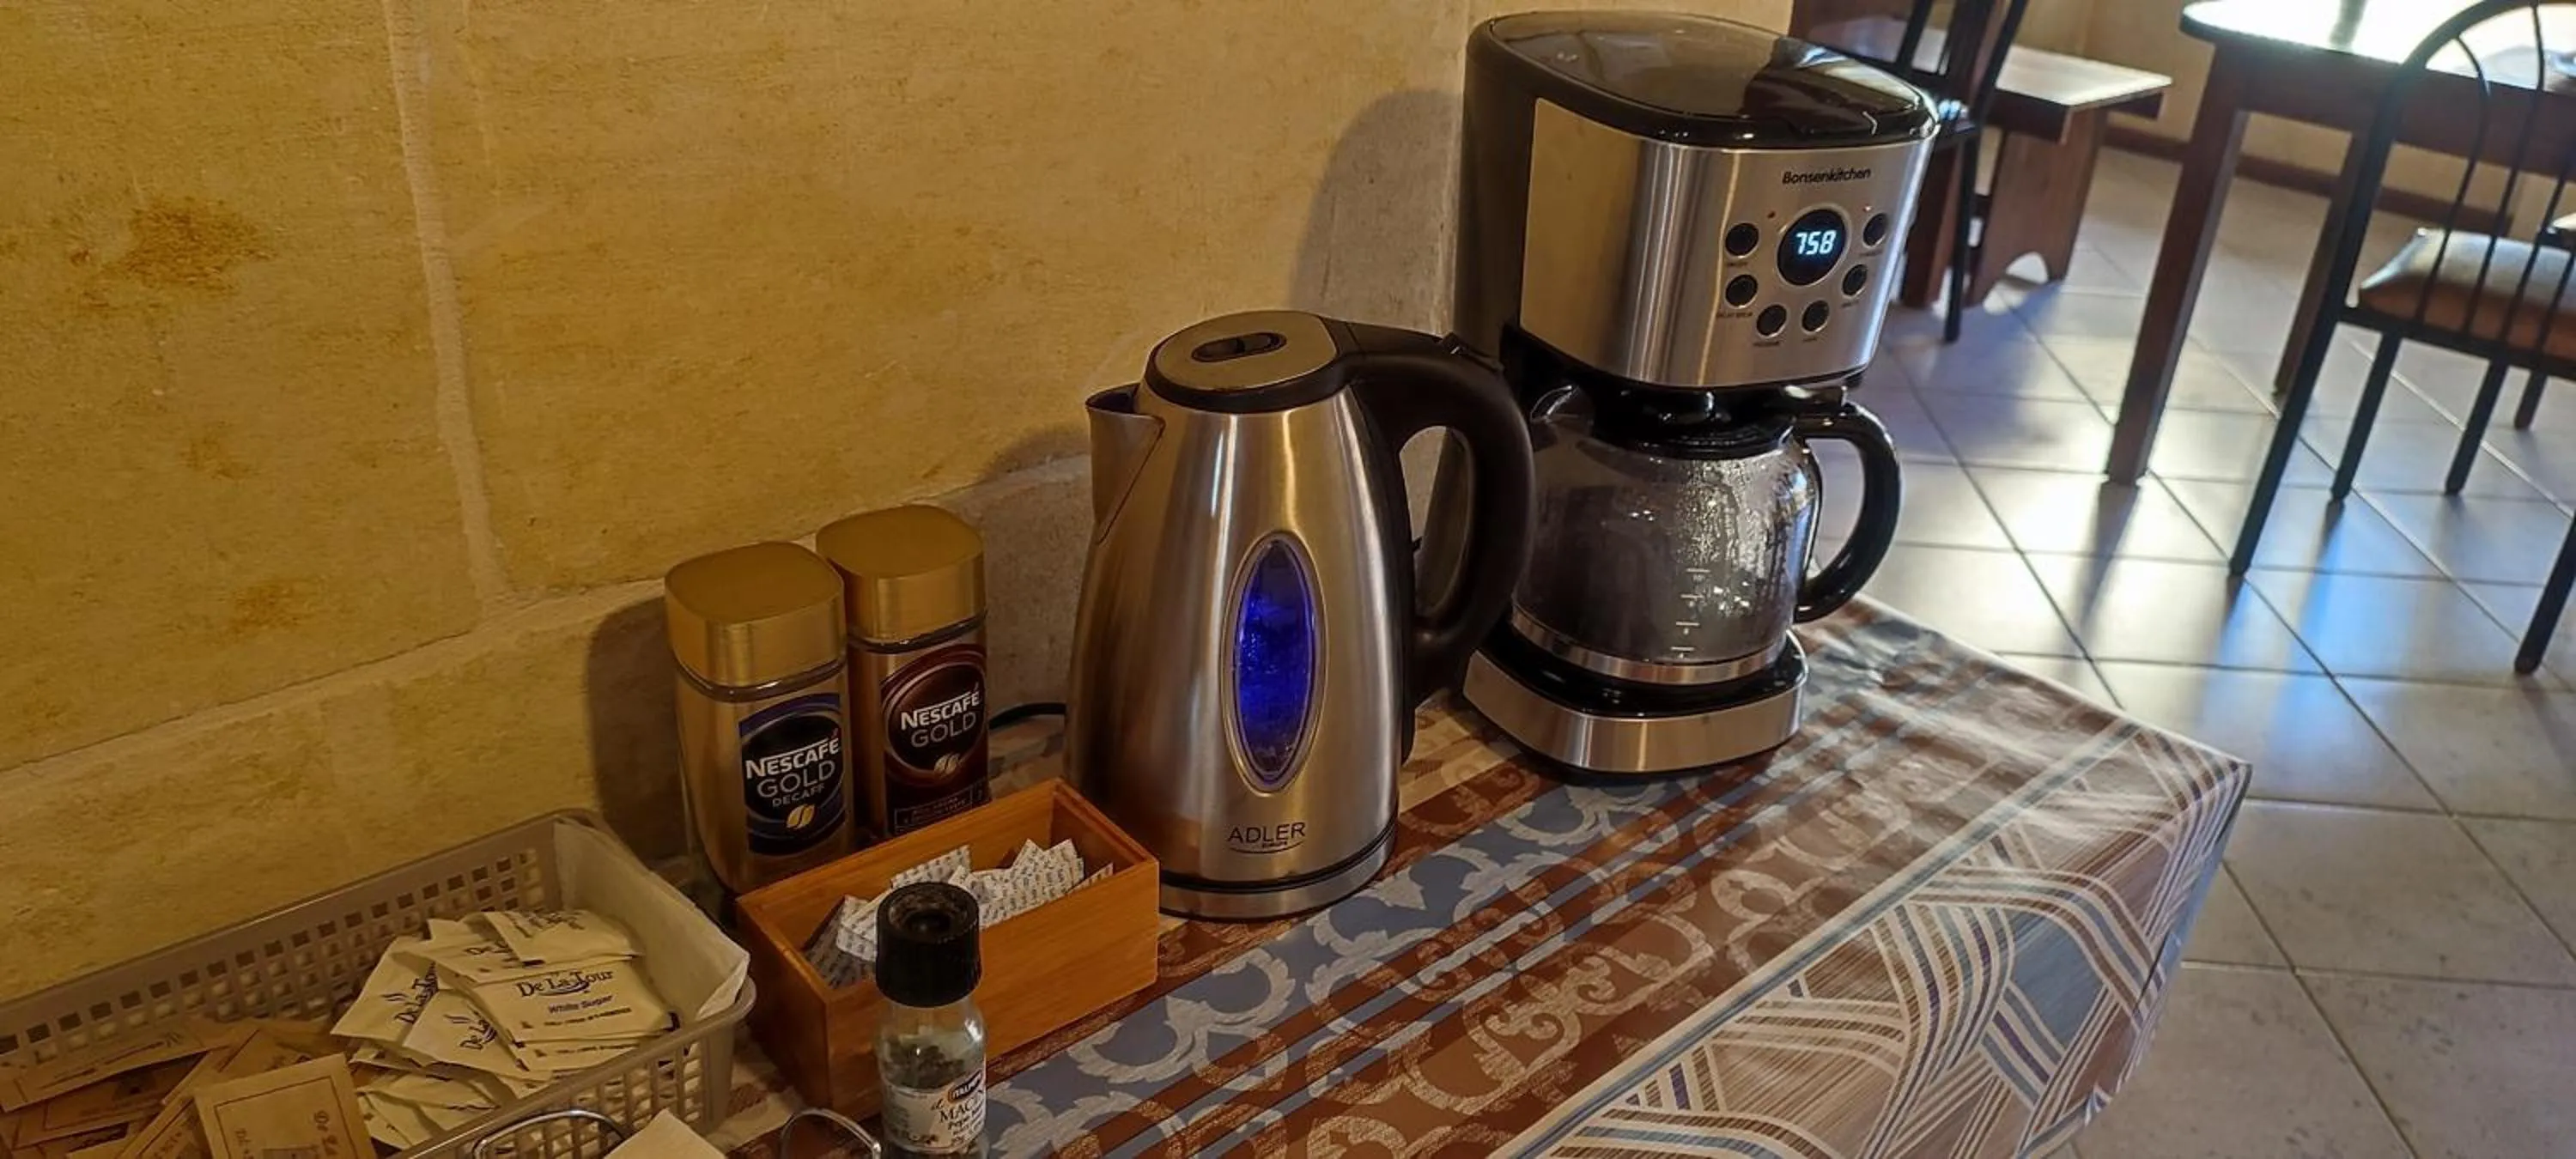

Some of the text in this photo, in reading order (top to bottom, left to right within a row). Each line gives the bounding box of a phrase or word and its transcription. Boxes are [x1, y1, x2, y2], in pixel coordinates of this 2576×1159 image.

[1782, 167, 1872, 185] Bonsenkitchen
[900, 682, 981, 731] NESCAFÉ
[911, 712, 976, 748] GOLD
[744, 727, 840, 780] NESCAFÉ
[756, 760, 835, 798] GOLD
[772, 785, 825, 807] DECAFF
[1227, 822, 1306, 843] ADLER
[515, 981, 544, 997] De
[568, 970, 614, 986] Tour
